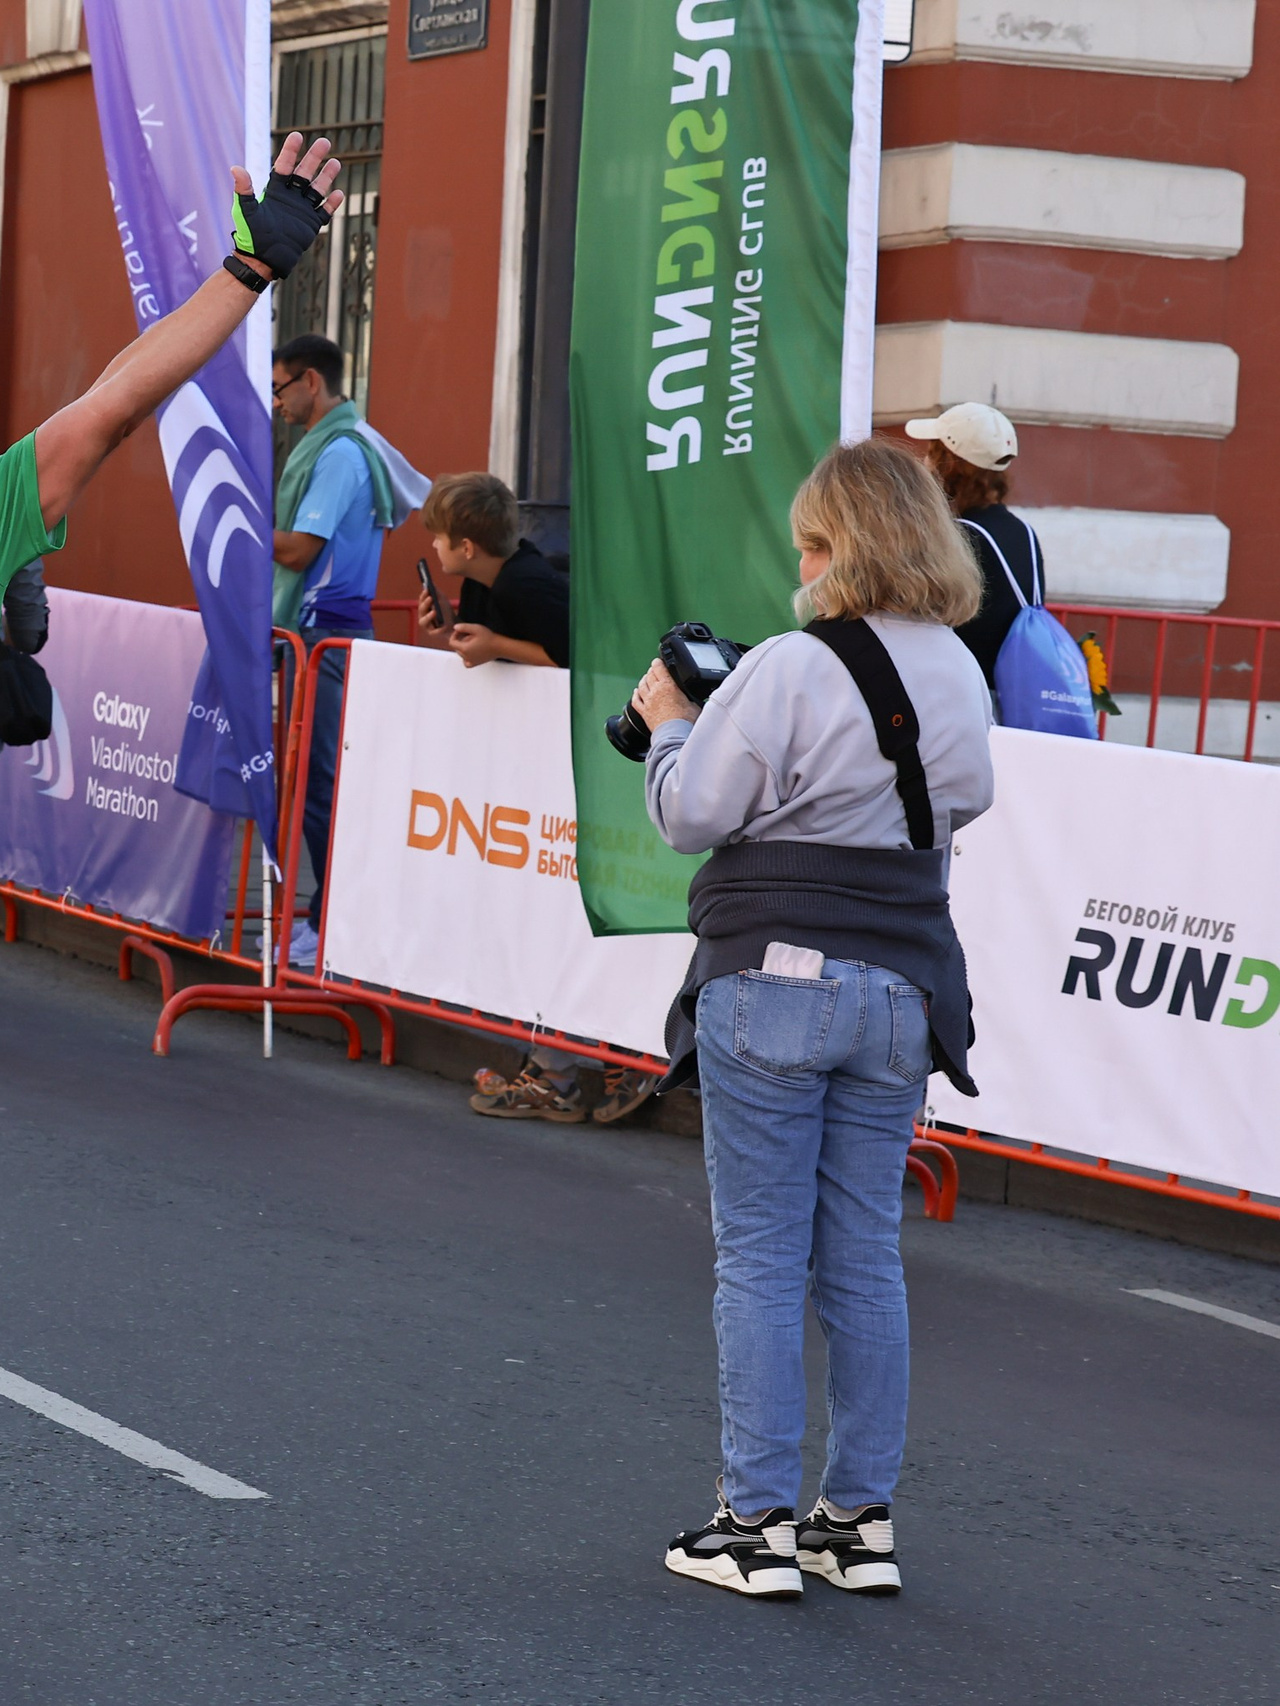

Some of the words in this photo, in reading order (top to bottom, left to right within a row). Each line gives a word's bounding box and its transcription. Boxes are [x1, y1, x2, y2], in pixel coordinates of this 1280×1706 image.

[93, 691, 150, 741] Galaxy
[85, 775, 159, 822] Marathon
[407, 789, 531, 869] DNS
[1083, 898, 1178, 933] БЕГОВОЙ
[1181, 915, 1236, 943] КЛУБ
[1061, 927, 1280, 1029] RUND
